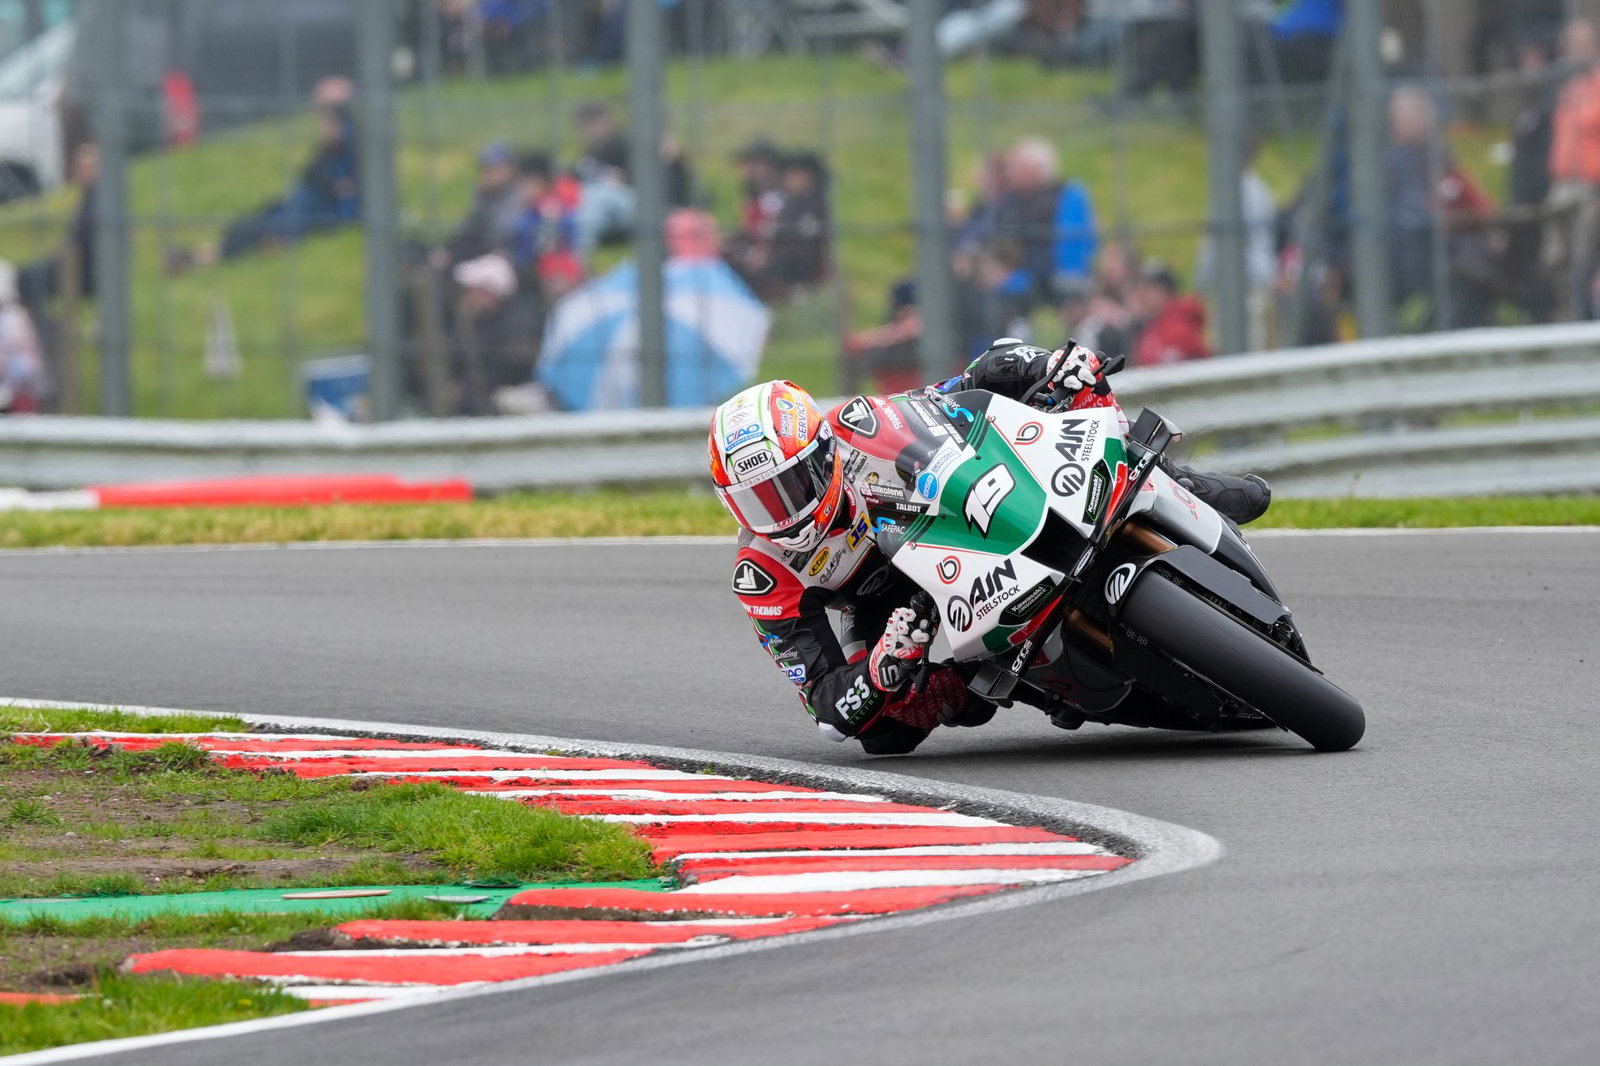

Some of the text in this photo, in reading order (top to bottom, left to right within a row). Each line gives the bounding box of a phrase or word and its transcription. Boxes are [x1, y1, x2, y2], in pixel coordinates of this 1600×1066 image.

[796, 400, 807, 440] SERVICE
[1055, 418, 1088, 462] AJN
[1081, 419, 1101, 462] STEELSTOCK
[737, 451, 769, 472] SHOEI
[740, 467, 780, 488] ROBINSONS
[895, 502, 922, 513] TALBOT
[963, 463, 1016, 540] 19
[1087, 474, 1099, 513] Kawasaki
[851, 517, 869, 547] JS
[881, 523, 906, 535] SAFEPAC
[969, 558, 1018, 609] AJN
[1010, 586, 1044, 612] Kawasaki
[753, 605, 782, 616] THOMAS
[976, 584, 1021, 620] STEELSTOCK
[849, 692, 879, 725] RACING
